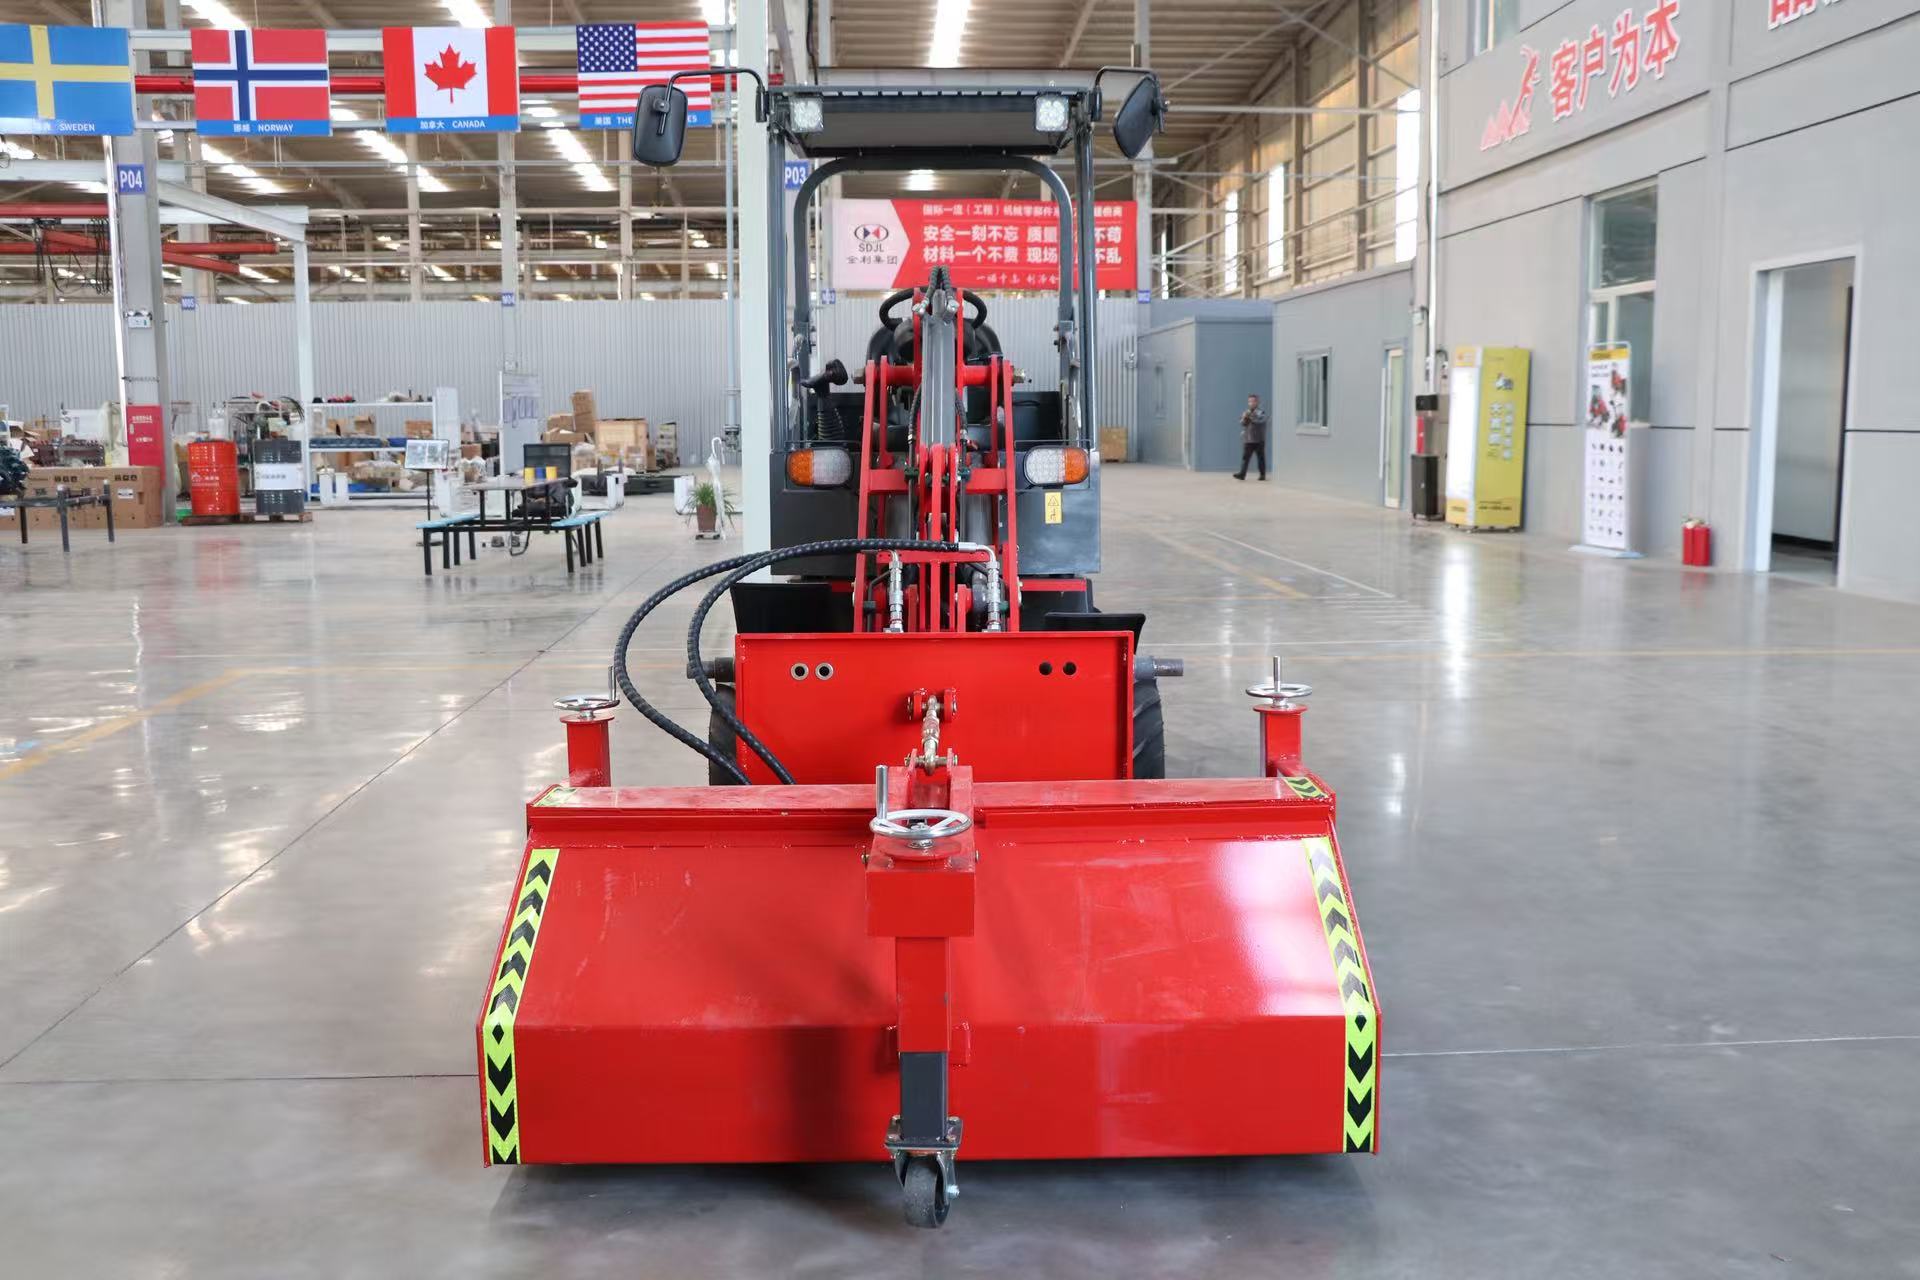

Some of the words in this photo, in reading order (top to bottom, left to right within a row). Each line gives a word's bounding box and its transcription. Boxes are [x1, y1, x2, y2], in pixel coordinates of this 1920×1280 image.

[1550, 0, 1680, 121] 客户为本
[420, 120, 444, 130] 加拿大
[452, 119, 486, 129] CANADA
[617, 116, 632, 124] THE
[59, 123, 96, 132] SWEDEN
[257, 123, 294, 133] NORWAY
[119, 170, 143, 189] P04
[785, 167, 806, 184] P03
[923, 224, 1019, 242] 安全一刻不忘
[1027, 225, 1122, 243] 质量不苟
[858, 243, 884, 253] SDJL
[1027, 246, 1122, 264] 现场不乱
